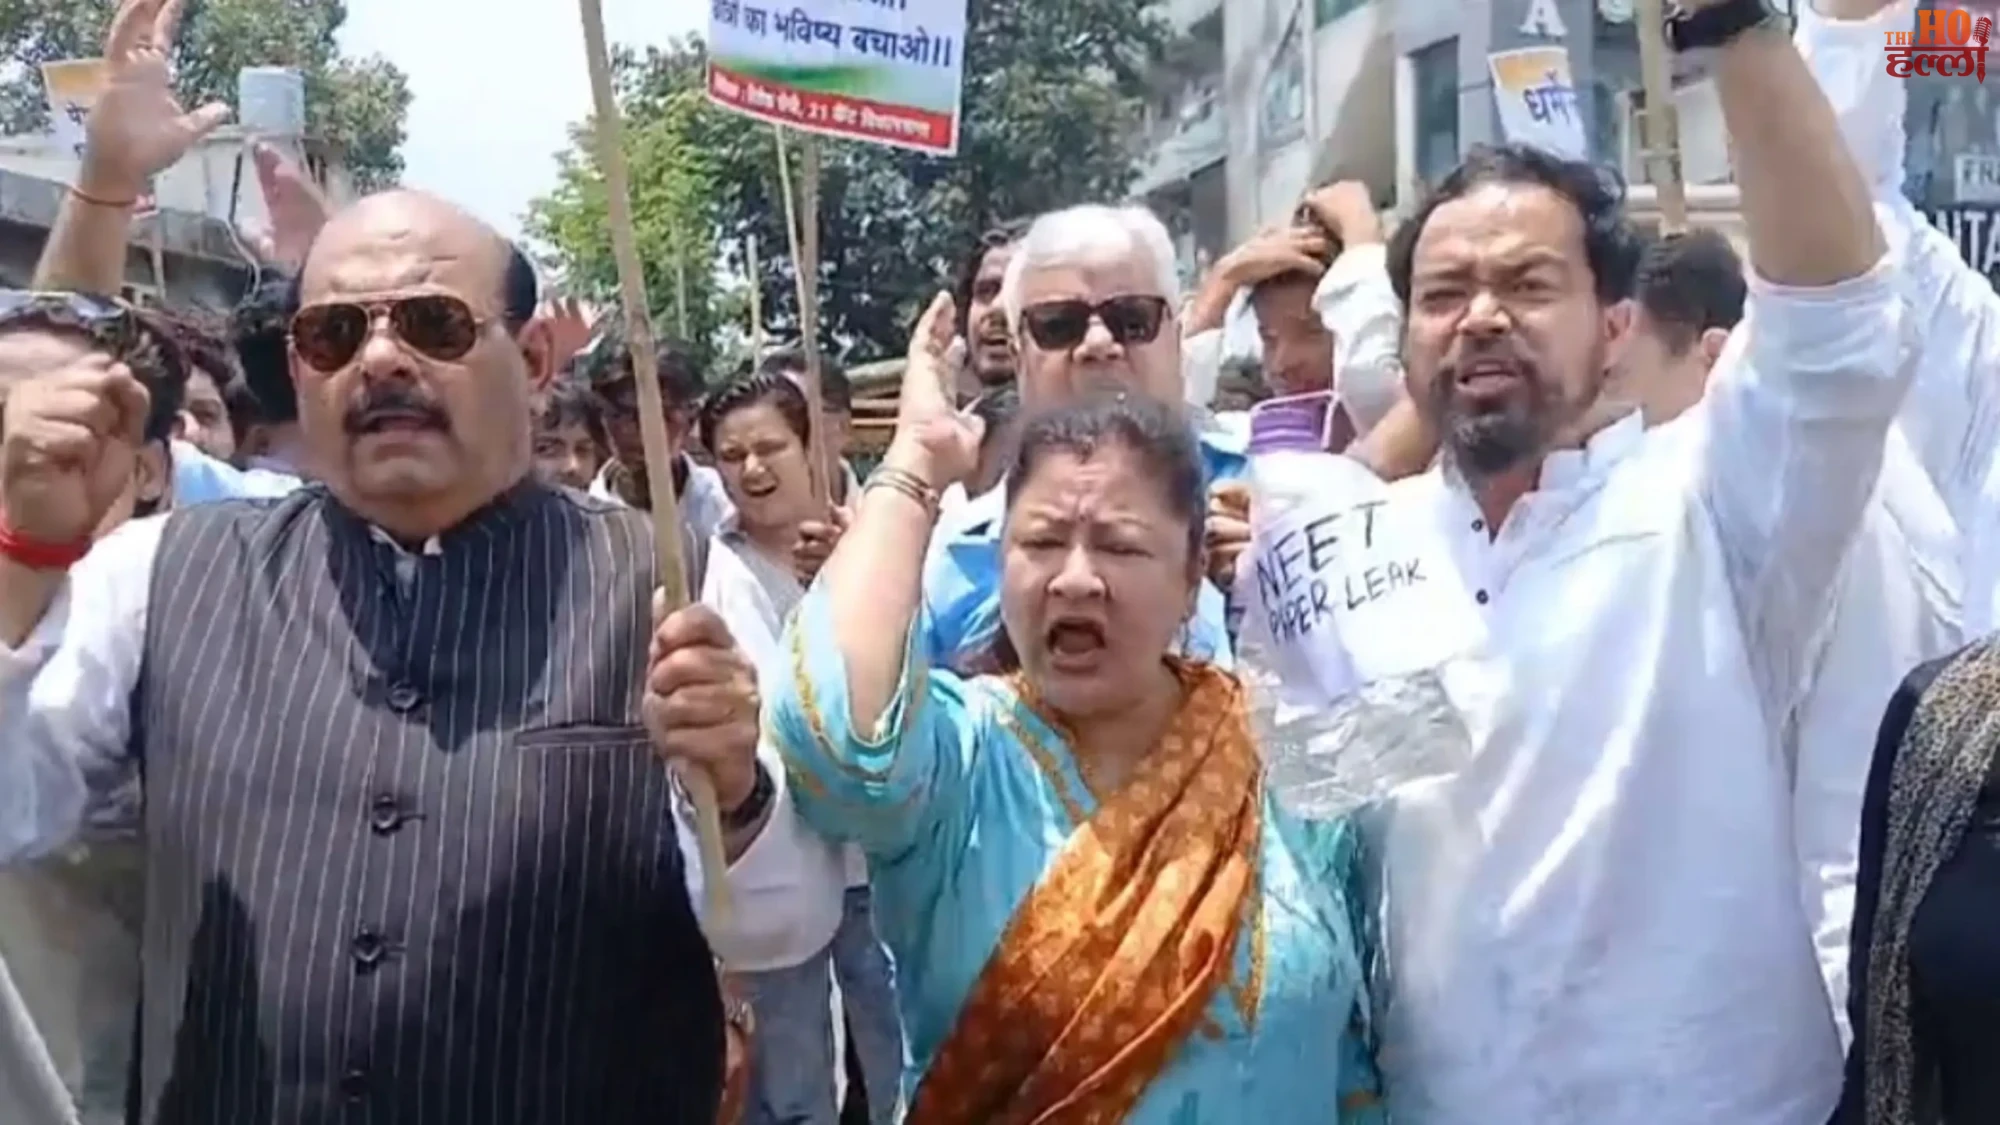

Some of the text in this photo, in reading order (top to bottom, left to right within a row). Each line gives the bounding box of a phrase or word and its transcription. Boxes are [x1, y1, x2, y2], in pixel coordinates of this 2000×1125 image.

[744, 6, 768, 37] का
[773, 7, 843, 50] भविष्य
[1256, 500, 1388, 609] NEET
[1268, 557, 1427, 645] PAPER LEAK
